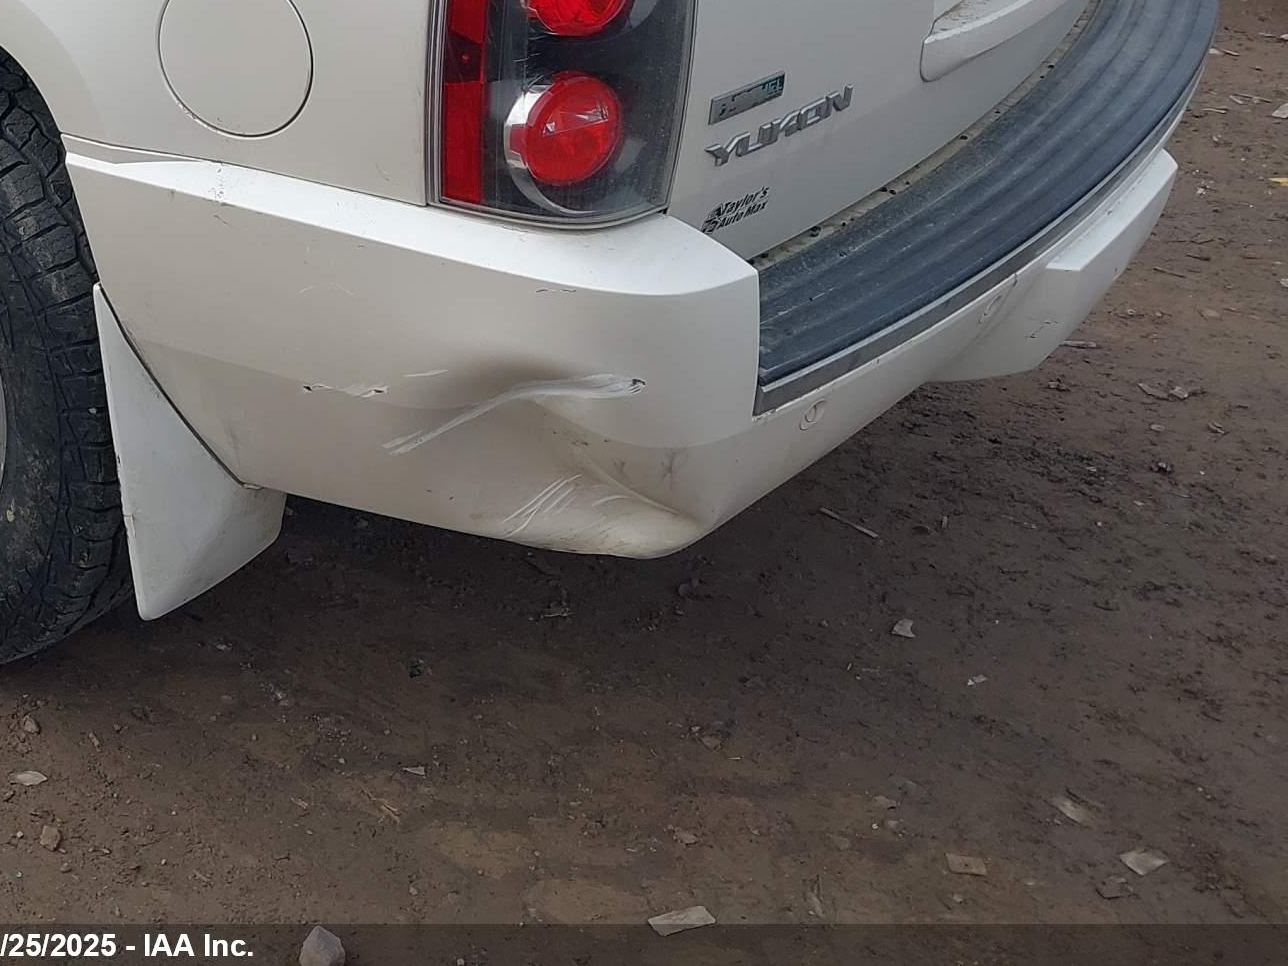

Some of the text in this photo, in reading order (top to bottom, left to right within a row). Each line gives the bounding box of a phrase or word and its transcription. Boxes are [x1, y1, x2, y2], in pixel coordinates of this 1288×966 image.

[704, 84, 854, 167] YUKON
[717, 200, 769, 230] Auto Max
[722, 186, 770, 215] Taylor's
